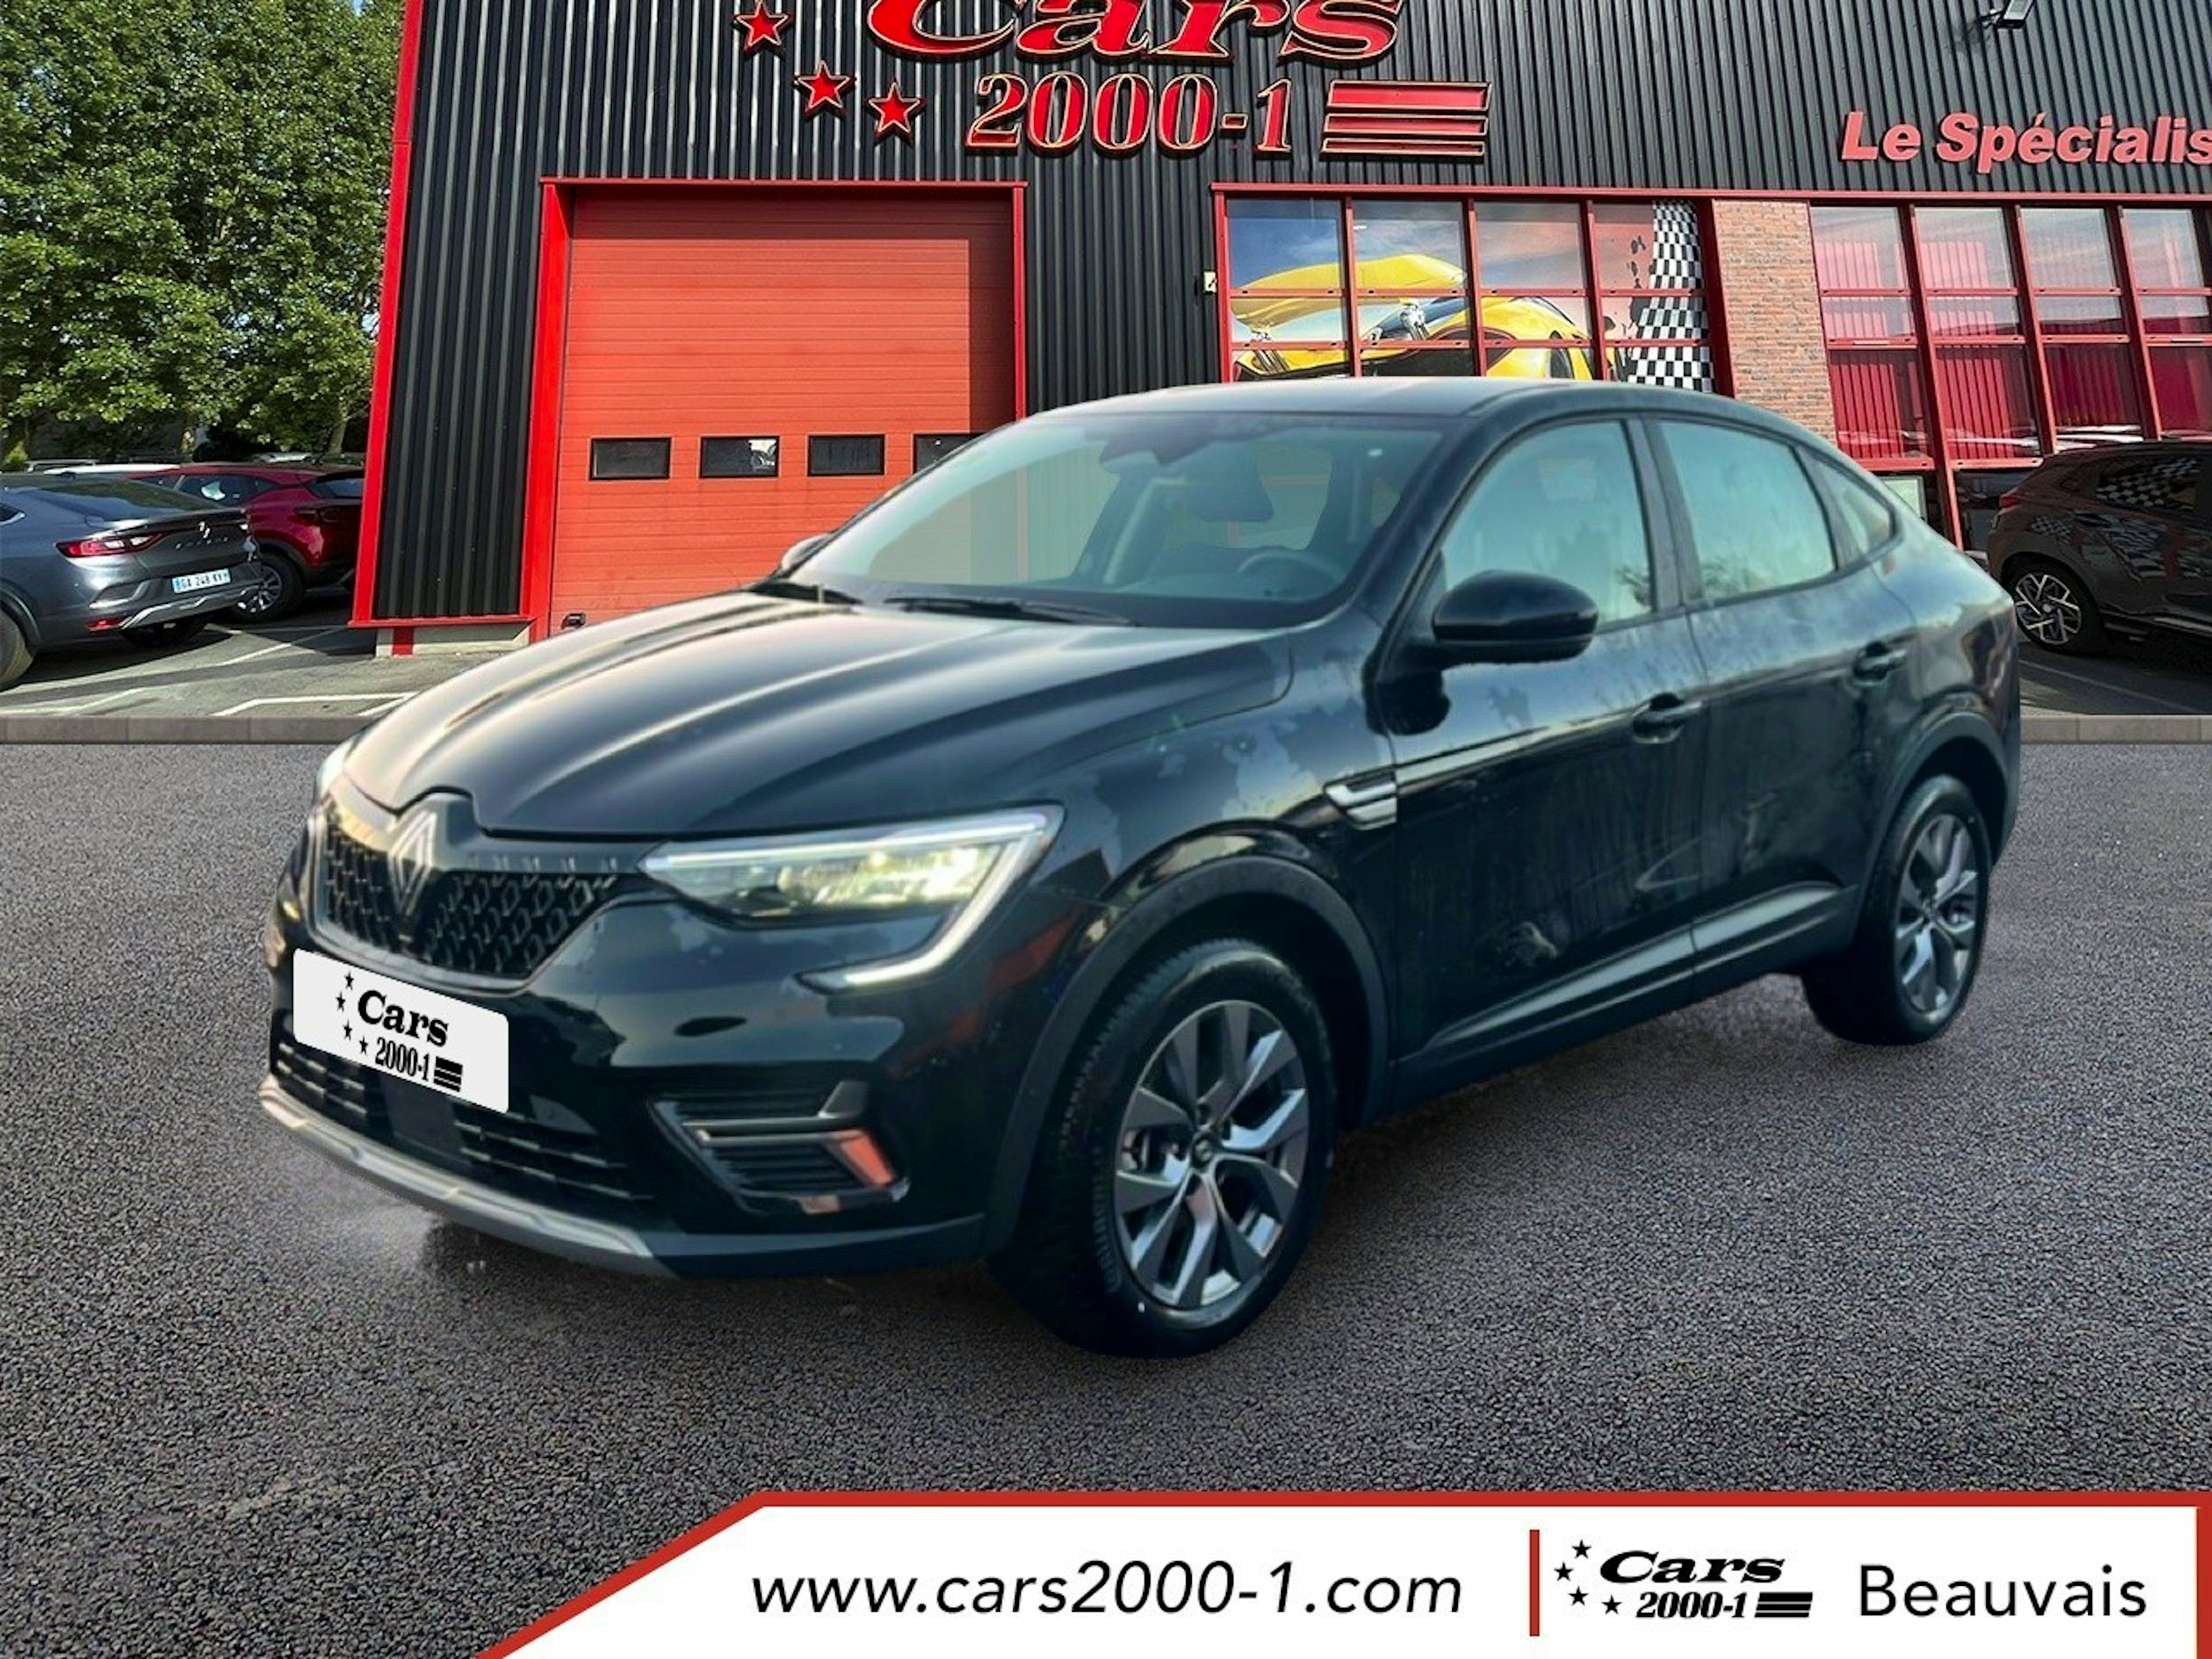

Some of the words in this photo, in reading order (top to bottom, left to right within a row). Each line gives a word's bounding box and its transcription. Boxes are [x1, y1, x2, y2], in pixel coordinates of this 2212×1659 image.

[867, 0, 1401, 61] Cars
[965, 70, 1292, 154] 2000-1
[1841, 111, 1922, 161] Le
